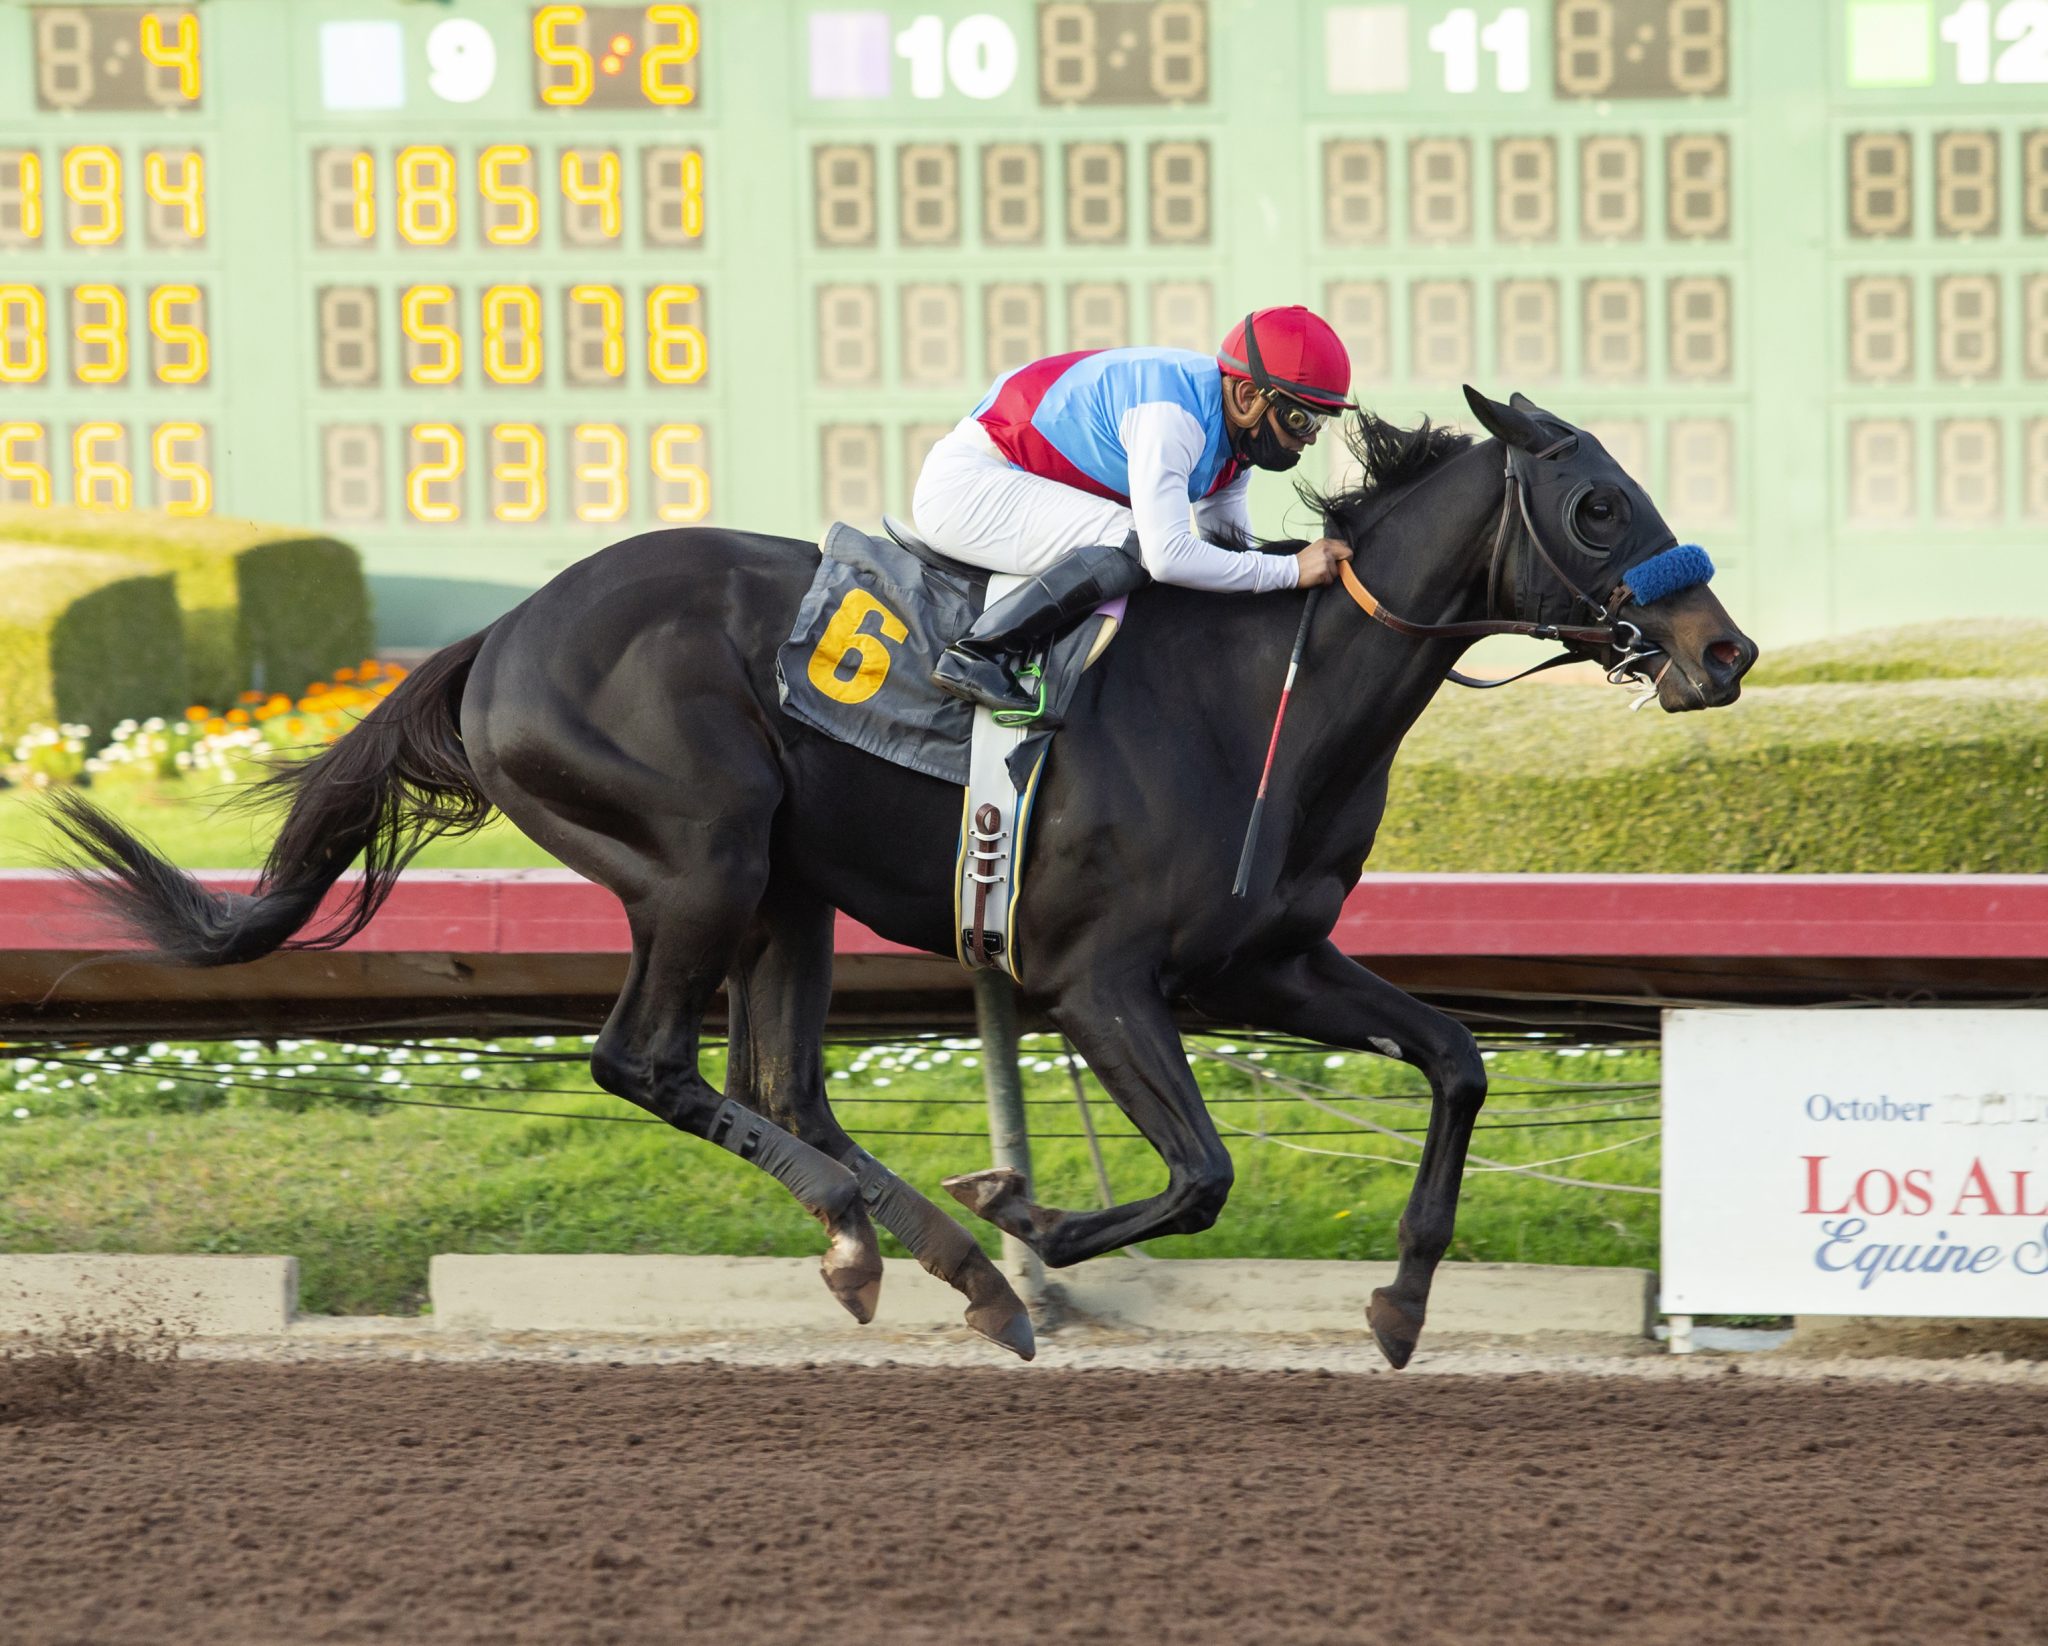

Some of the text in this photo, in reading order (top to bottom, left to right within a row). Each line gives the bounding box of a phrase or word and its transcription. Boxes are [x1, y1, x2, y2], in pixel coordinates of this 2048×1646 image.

[426, 18, 497, 102] 9
[895, 13, 1018, 99] 10
[1428, 8, 1530, 93] 11
[807, 588, 909, 704] 6
[1805, 1094, 1932, 1122] October
[1814, 1217, 2006, 1291] Equine
